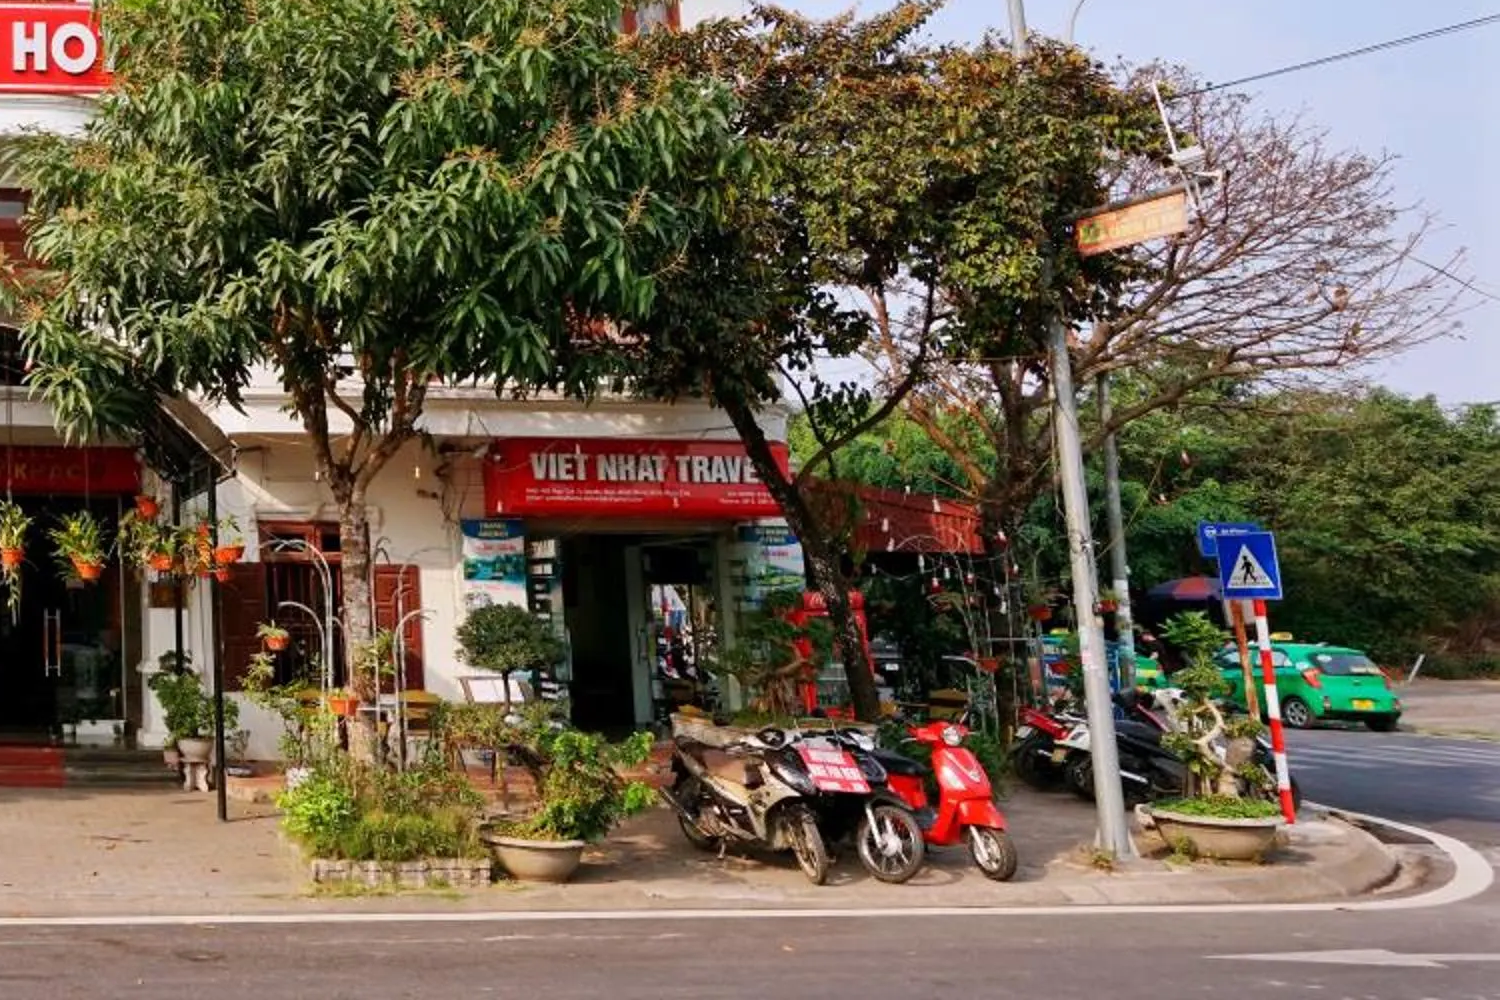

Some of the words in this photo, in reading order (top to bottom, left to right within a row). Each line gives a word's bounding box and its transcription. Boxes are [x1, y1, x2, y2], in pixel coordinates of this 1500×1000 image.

[12, 21, 115, 74] HO
[530, 453, 589, 481] VIET
[597, 454, 667, 482] NHAT
[675, 455, 762, 484] TRAVE
